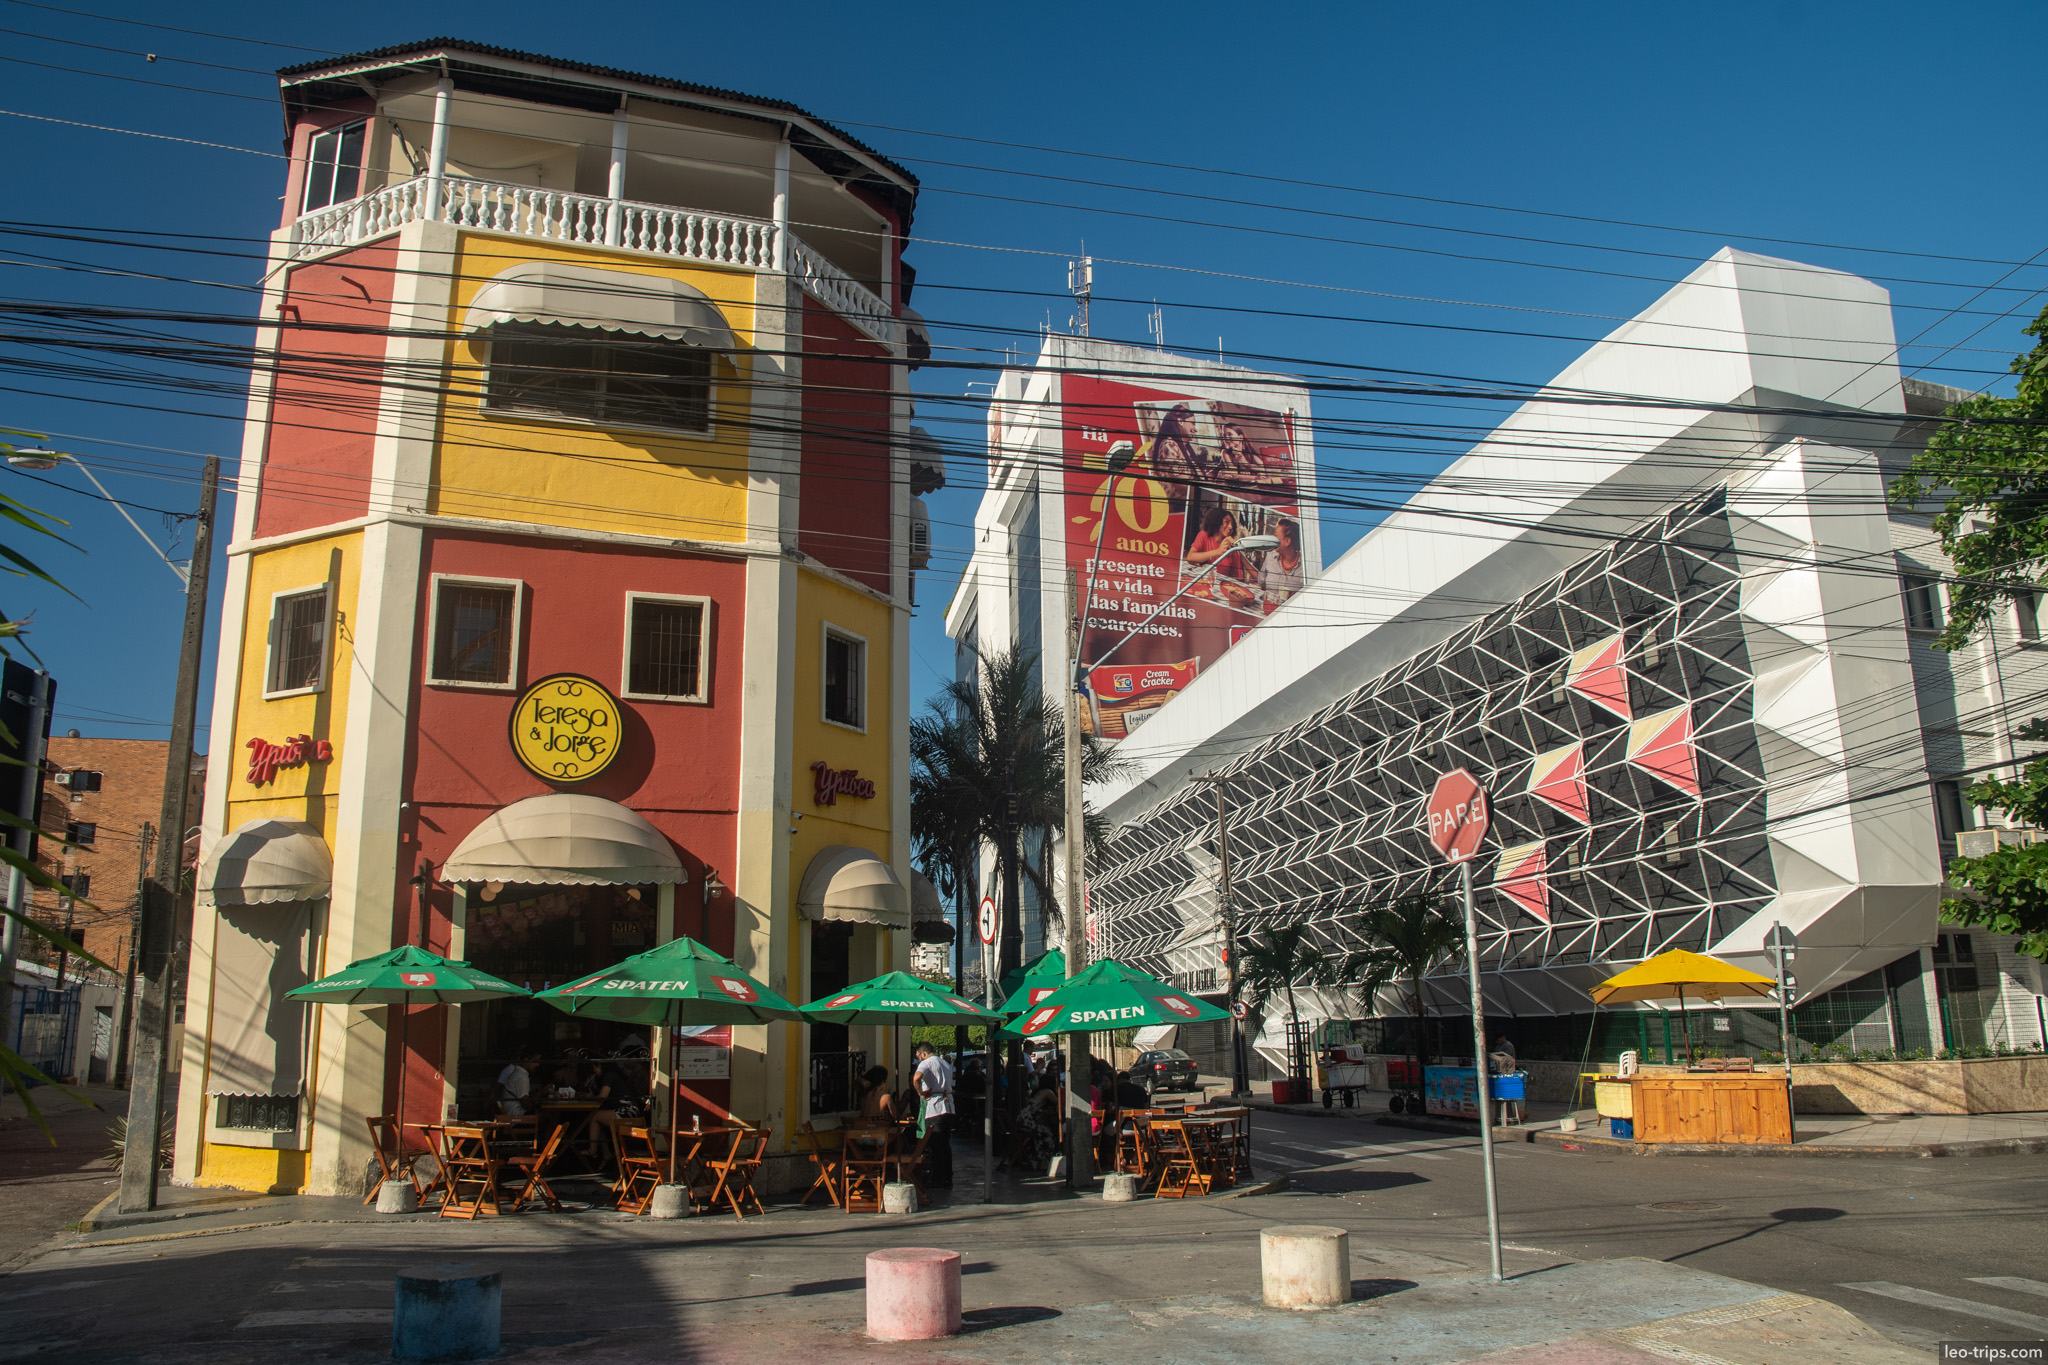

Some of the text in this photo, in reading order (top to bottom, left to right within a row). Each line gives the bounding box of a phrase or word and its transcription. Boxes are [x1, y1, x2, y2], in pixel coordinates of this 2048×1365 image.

[1116, 537, 1170, 556] anos
[1085, 558, 1165, 578] presente
[1086, 577, 1154, 596] na vida
[1140, 677, 1175, 688] Cracker
[1145, 670, 1170, 679] Cream
[532, 698, 608, 734] Teresa
[529, 726, 607, 762] & Jorge
[1430, 797, 1484, 837] PARE
[603, 979, 690, 991] SPATEN
[880, 999, 934, 1009] SPATEN
[1070, 1005, 1145, 1024] SPATEN
